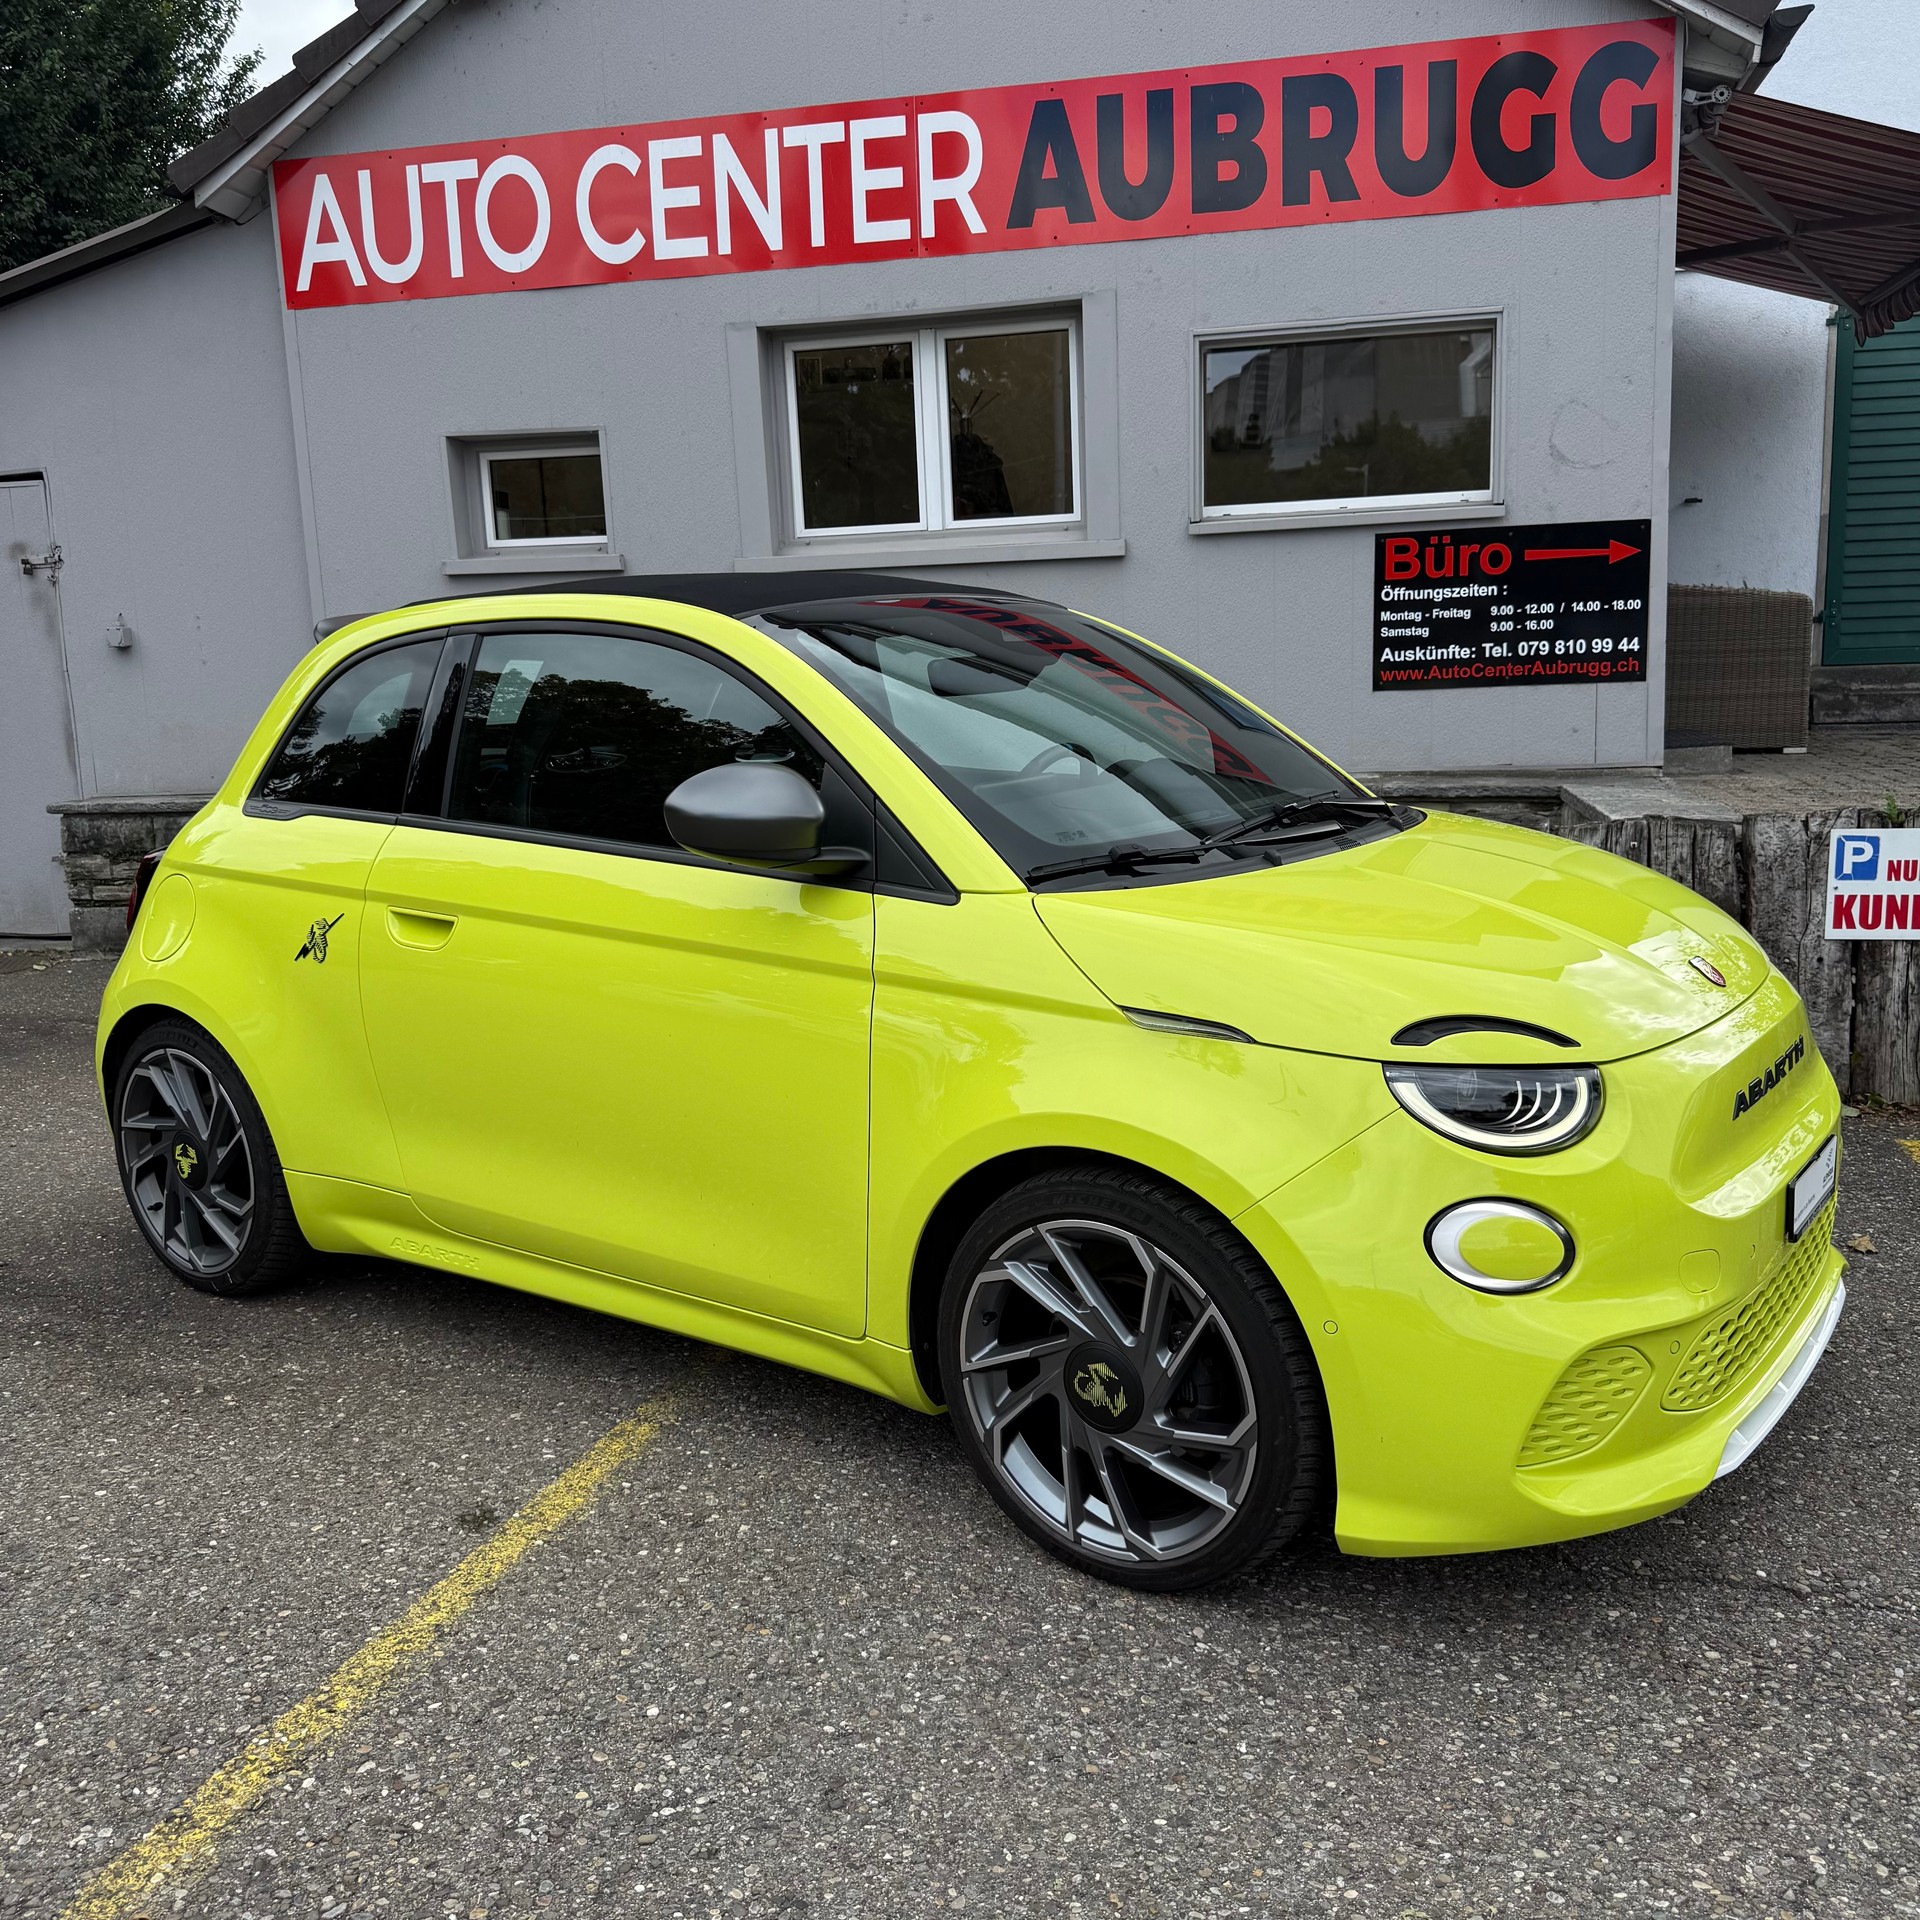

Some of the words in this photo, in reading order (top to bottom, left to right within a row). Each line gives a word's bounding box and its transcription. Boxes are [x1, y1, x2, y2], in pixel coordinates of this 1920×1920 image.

[297, 155, 551, 291] AUTO
[576, 111, 986, 265] CENTER
[1006, 40, 1660, 229] AUBRUGG
[1385, 535, 1512, 580] Büro
[1380, 611, 1422, 622] Montag
[1432, 608, 1471, 620] Freitag
[1490, 605, 1514, 616] 9.00
[1524, 603, 1554, 614] 12.00
[1571, 601, 1601, 612] 14.00
[1611, 599, 1641, 611] 18.00
[1380, 626, 1430, 637] Samstag
[1490, 621, 1514, 632] 9.00
[1524, 619, 1554, 631] 16.00
[1380, 644, 1476, 662] Auskünfte:
[1482, 642, 1512, 658] Tel.
[1518, 640, 1549, 656] 079
[1555, 639, 1586, 654] 810
[1592, 638, 1612, 653] 99
[1617, 636, 1640, 652] 44
[1380, 656, 1640, 682] www.AutoCenterAubrugg.ch
[1843, 841, 1874, 874] P
[1887, 860, 1920, 881] NU
[1733, 1034, 1804, 1121] ABARTH
[391, 1237, 479, 1270] ABARTH
